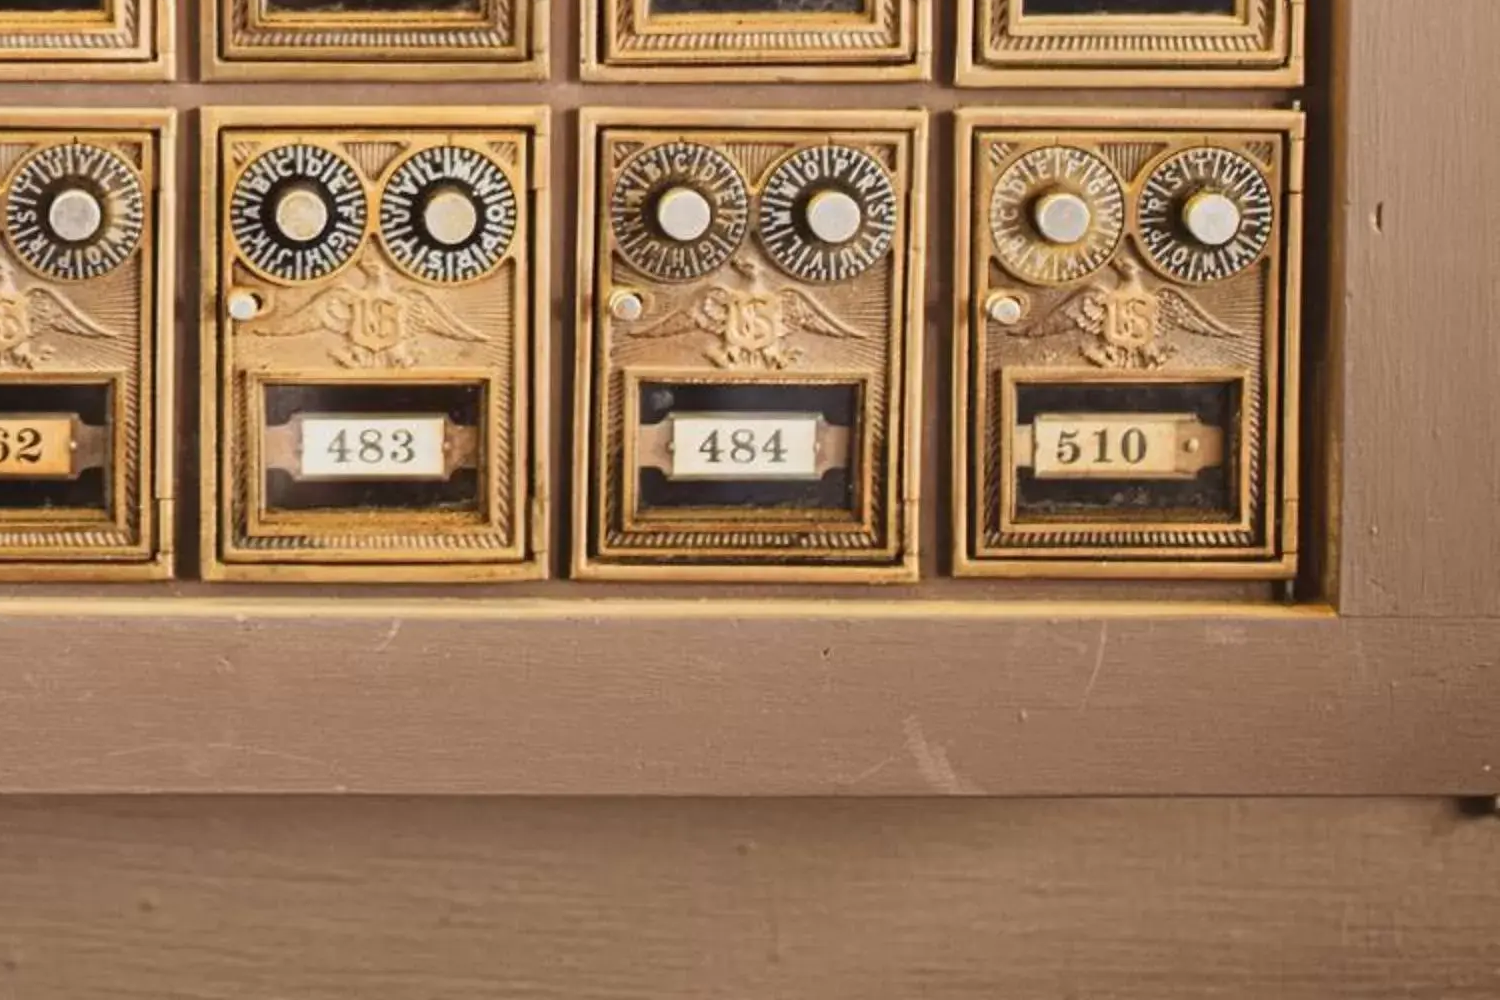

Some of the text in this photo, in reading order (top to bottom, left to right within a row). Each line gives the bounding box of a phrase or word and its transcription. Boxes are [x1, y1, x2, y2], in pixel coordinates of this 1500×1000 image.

[44, 157, 64, 178] U
[77, 156, 94, 175] V
[274, 156, 293, 177] C
[304, 157, 324, 177] D
[423, 161, 442, 180] L
[451, 159, 473, 180] M
[803, 160, 819, 181] O
[833, 158, 849, 178] P
[1191, 159, 1208, 177] T
[327, 429, 416, 464] 483
[698, 429, 788, 464] 484
[1056, 427, 1148, 465] 510
